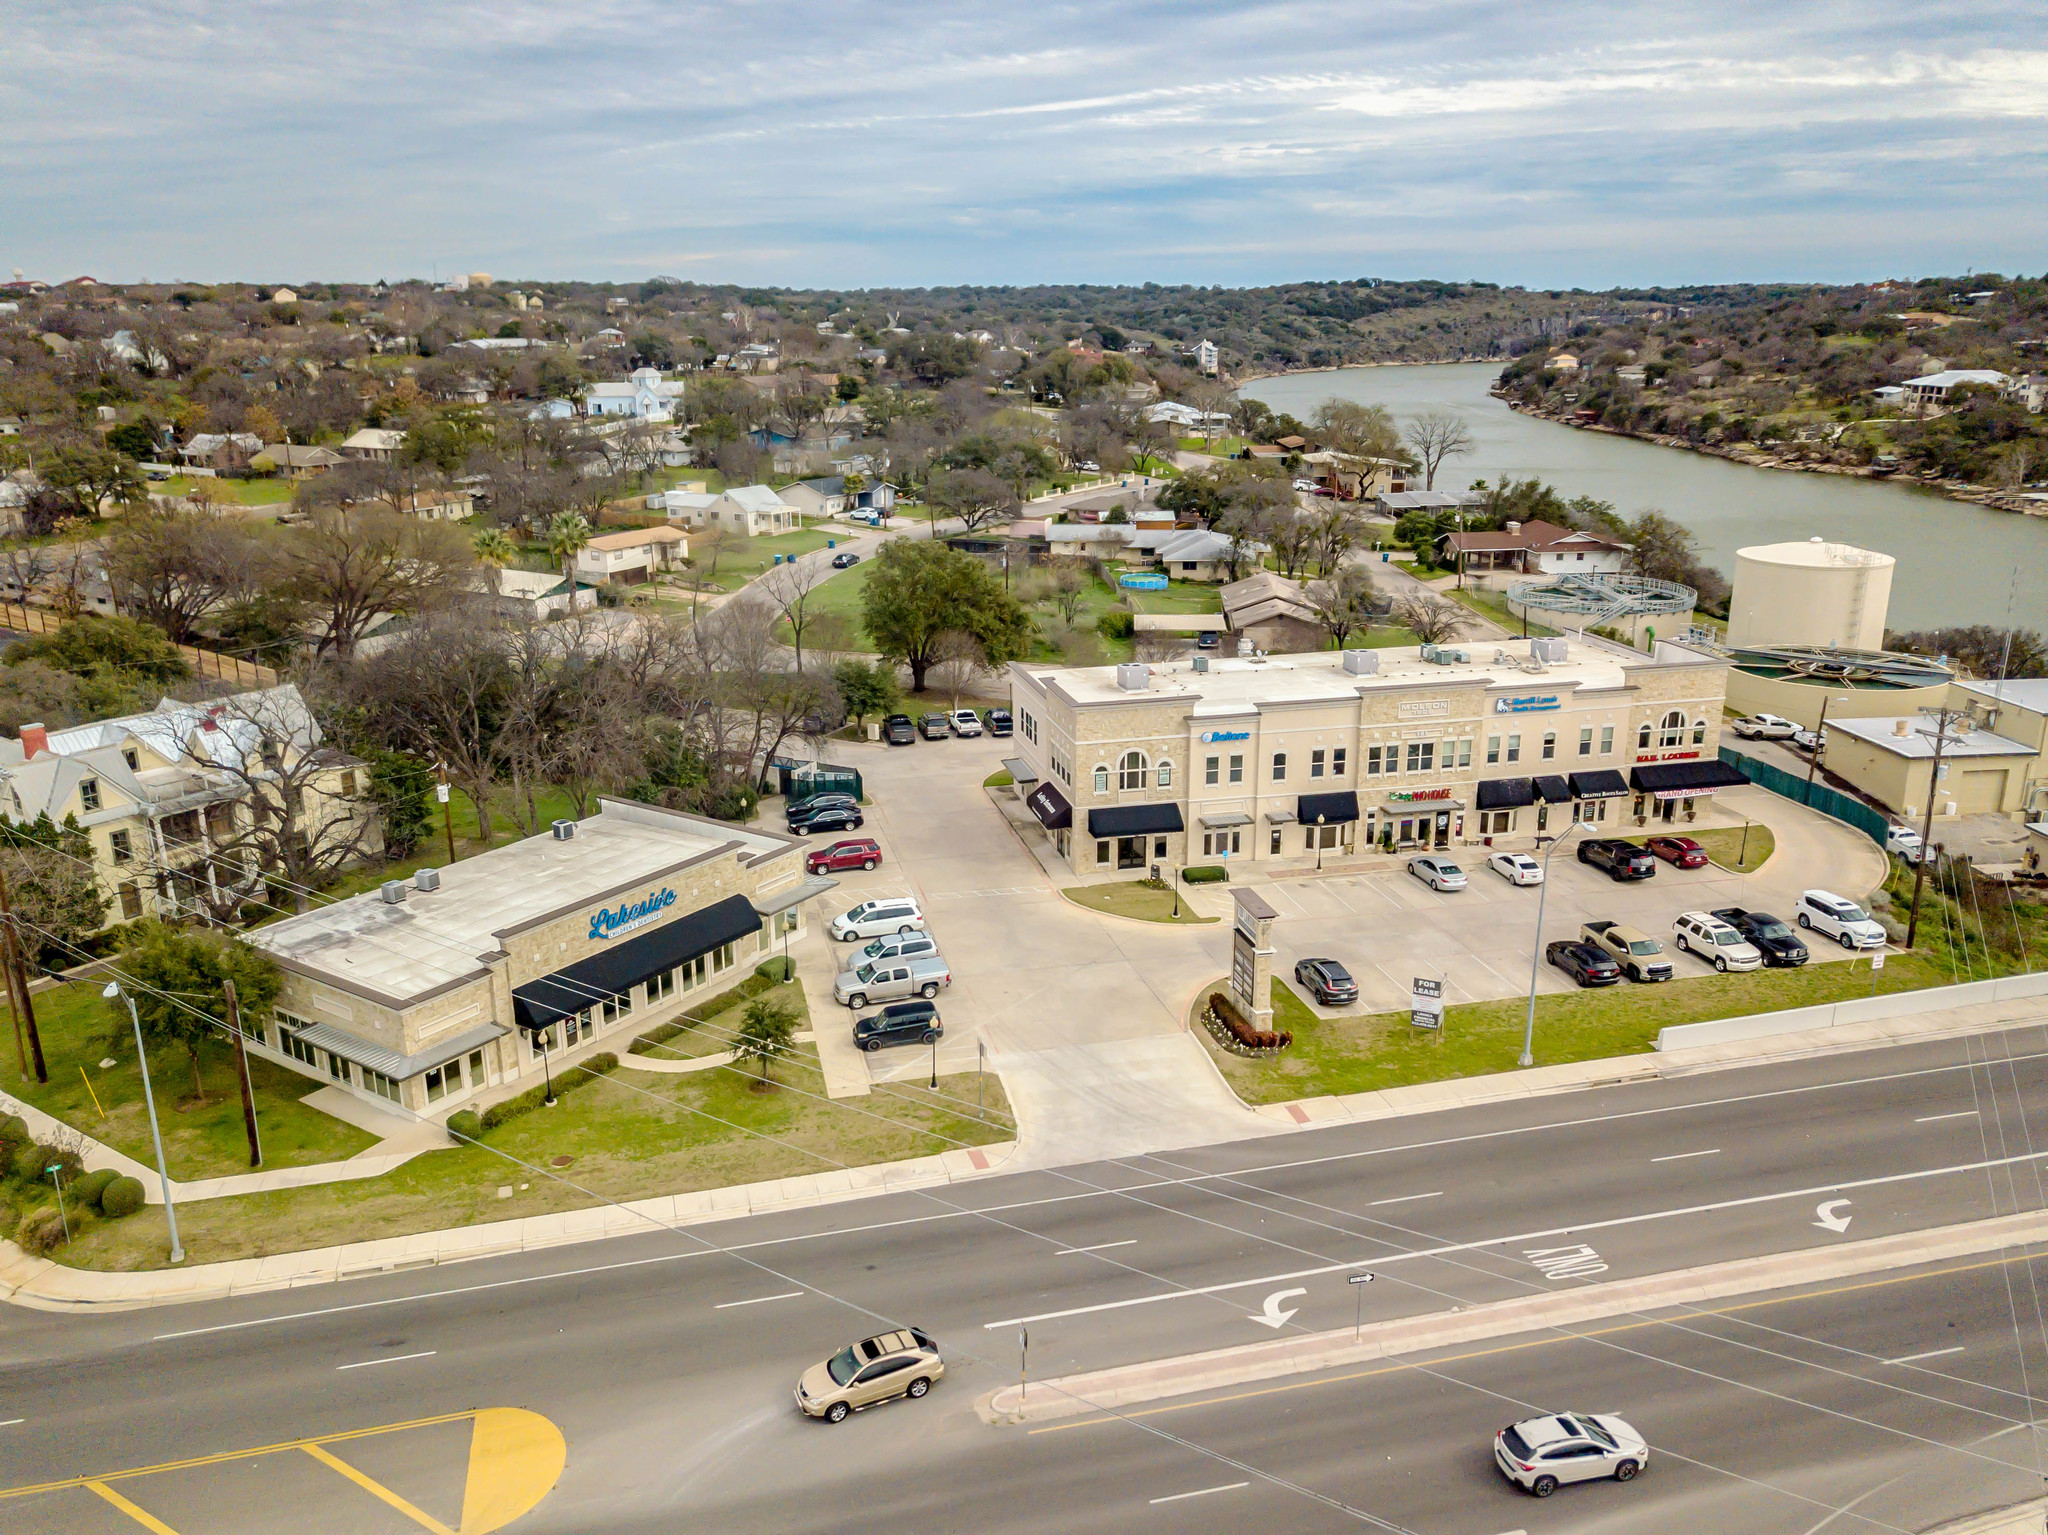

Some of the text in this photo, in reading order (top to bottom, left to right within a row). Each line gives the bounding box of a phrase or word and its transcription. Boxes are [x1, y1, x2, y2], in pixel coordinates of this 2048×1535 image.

[1211, 731, 1250, 742] Beltone
[589, 887, 677, 939] Lakeside
[1418, 980, 1436, 989] FOR
[1413, 987, 1440, 997] LEASE
[1522, 1243, 1609, 1280] ONLY
